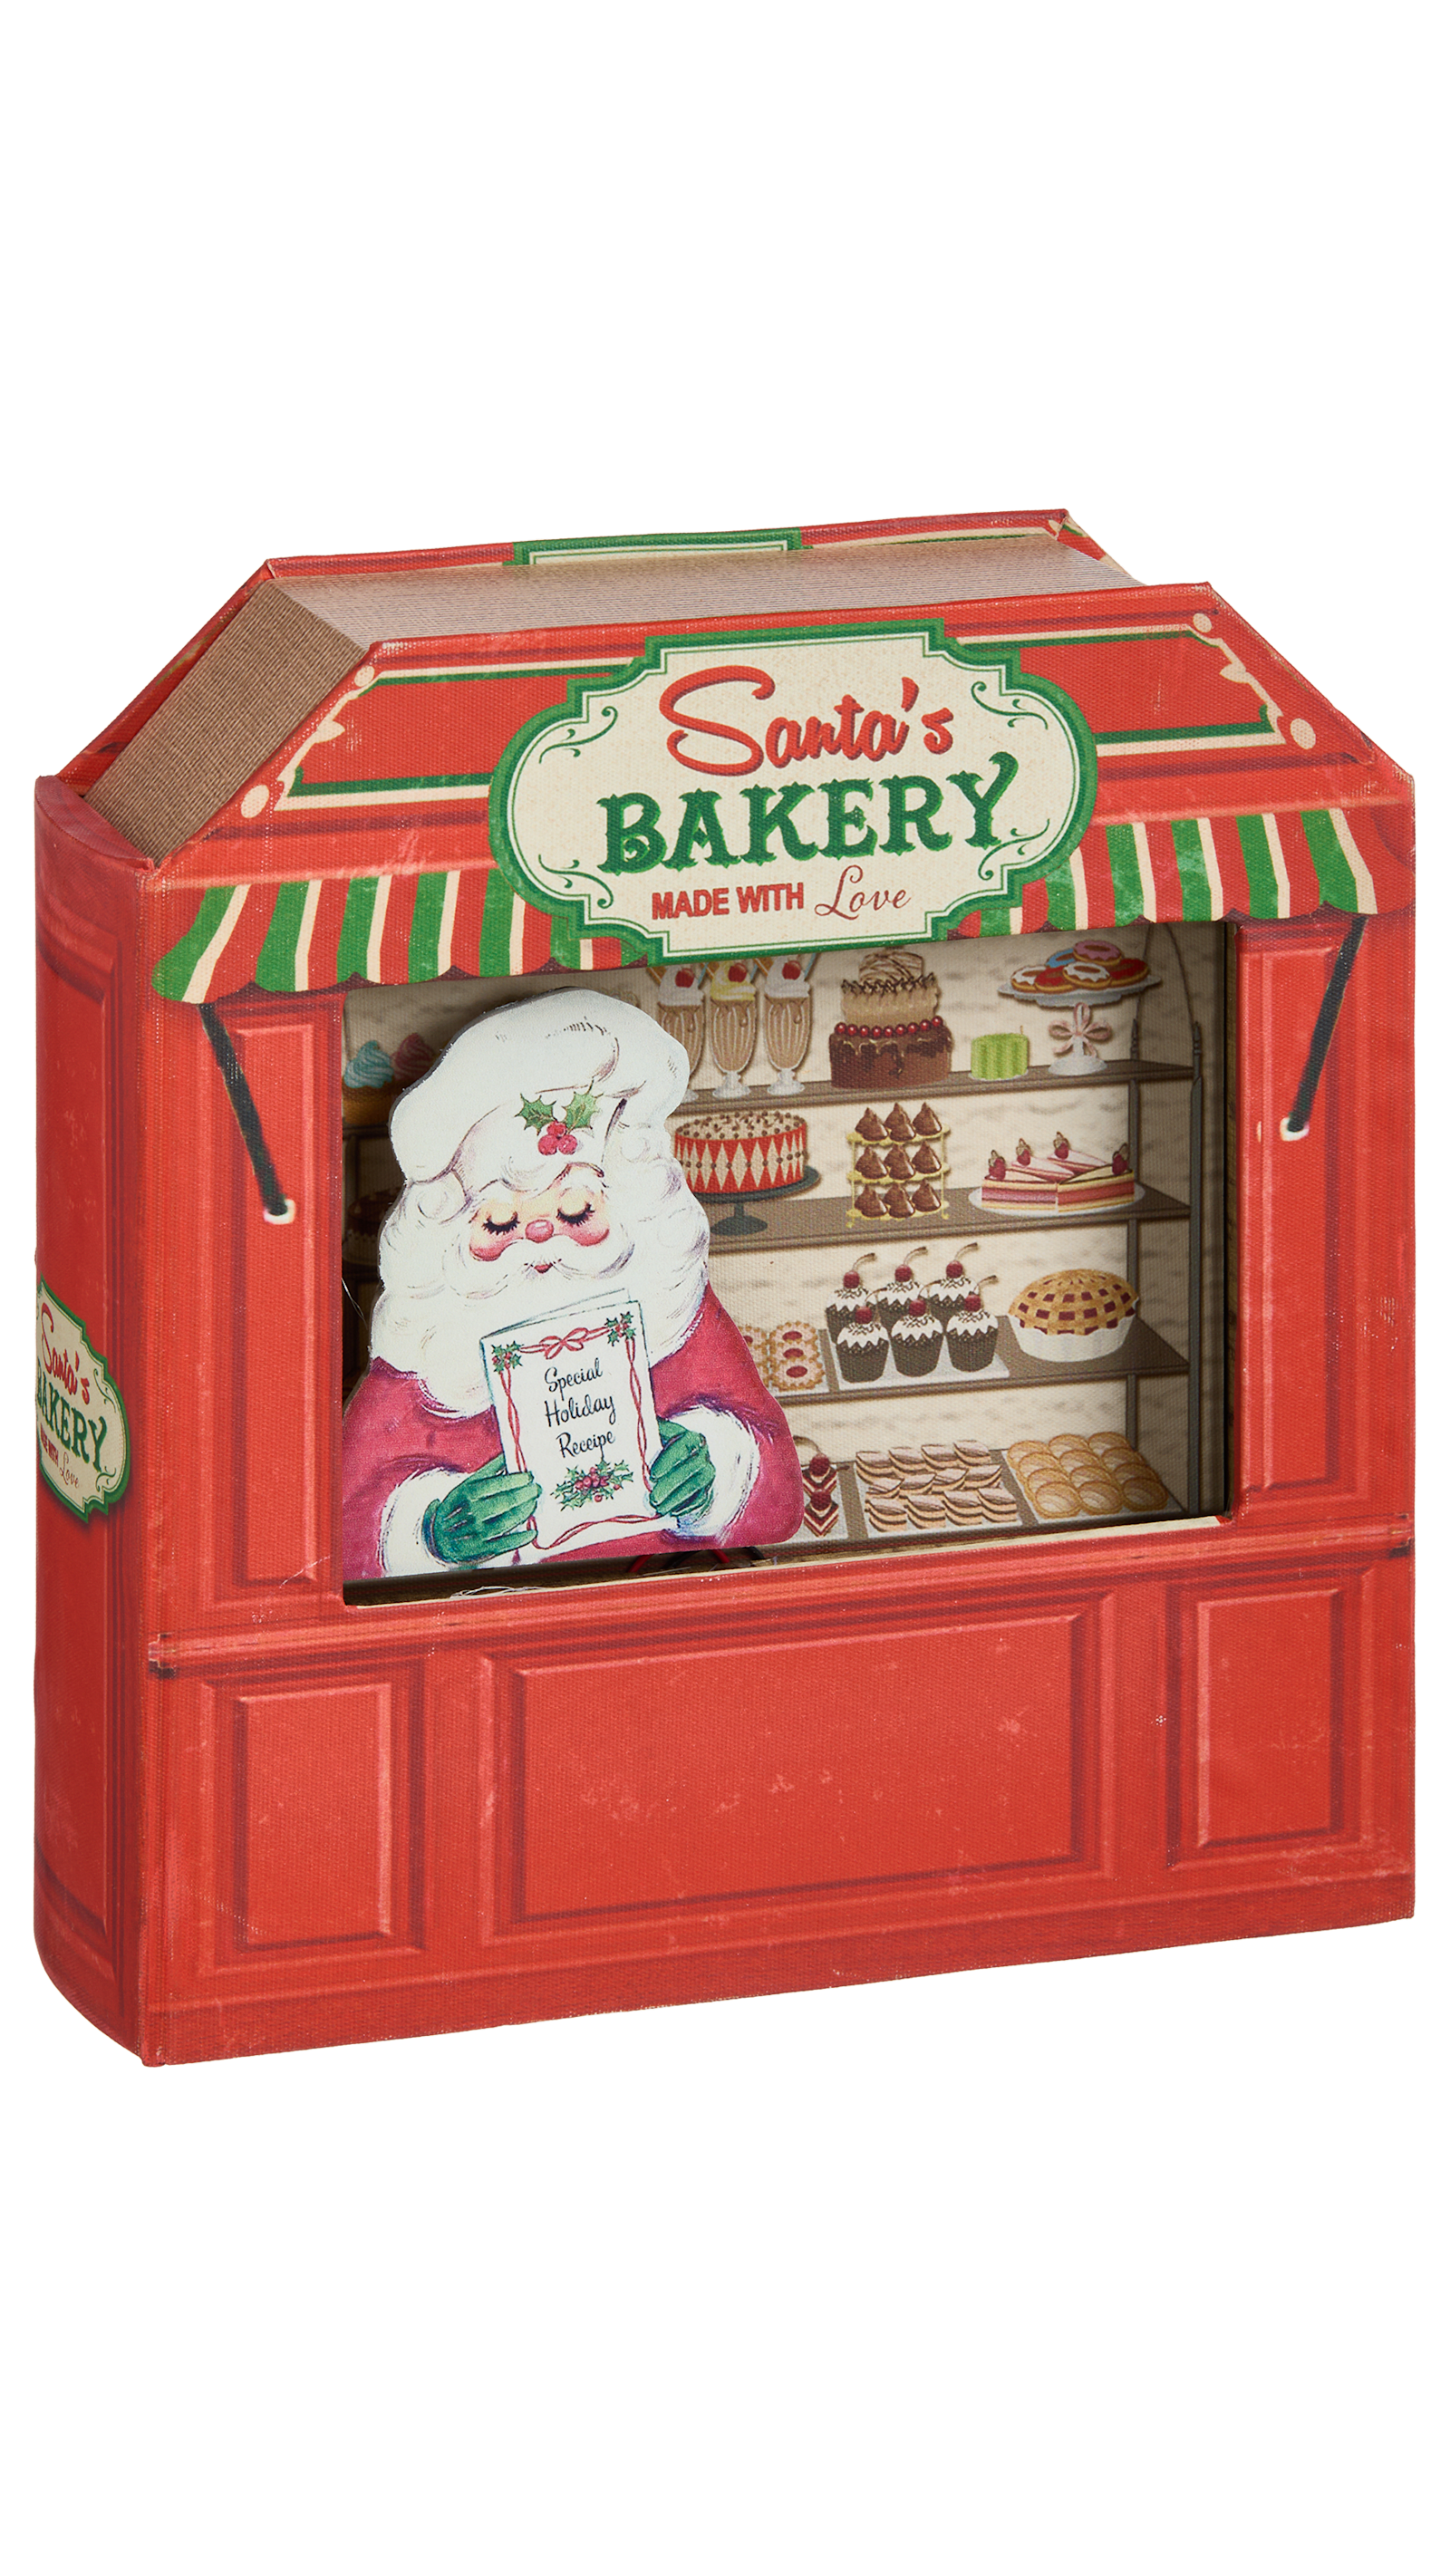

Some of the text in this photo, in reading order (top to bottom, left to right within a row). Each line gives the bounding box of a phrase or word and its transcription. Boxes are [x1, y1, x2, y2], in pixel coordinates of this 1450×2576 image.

[659, 664, 955, 777] Santa's
[596, 751, 1019, 875] BAKERY
[651, 864, 911, 921] MADE WITH Love
[41, 1302, 90, 1405] Santa's
[544, 1357, 604, 1401] Special
[544, 1394, 616, 1428] Holiday
